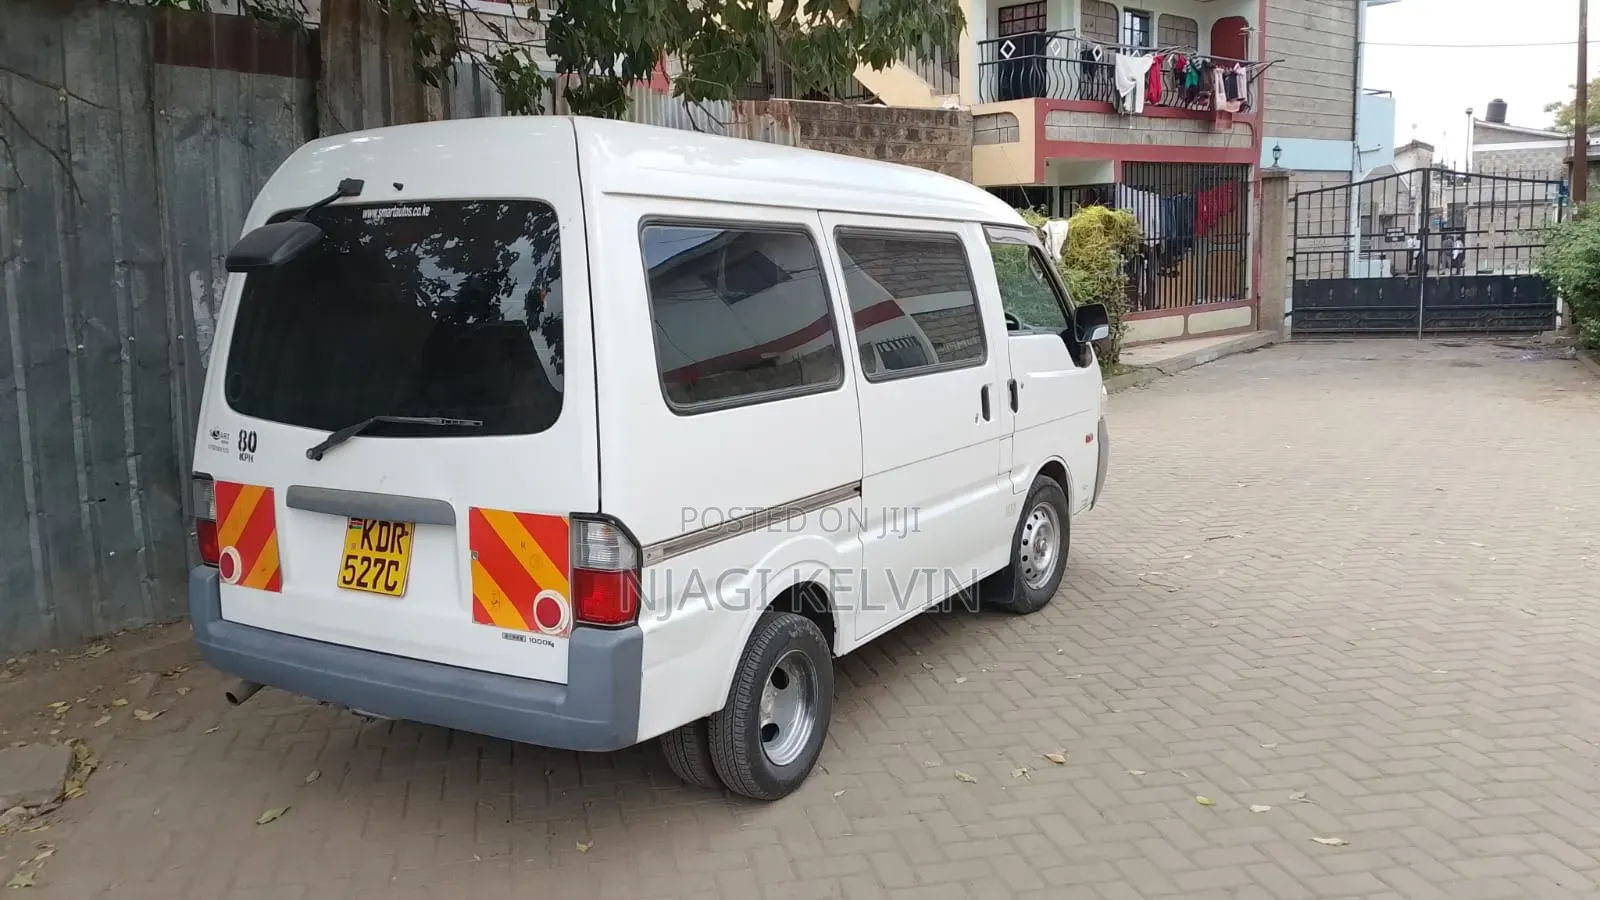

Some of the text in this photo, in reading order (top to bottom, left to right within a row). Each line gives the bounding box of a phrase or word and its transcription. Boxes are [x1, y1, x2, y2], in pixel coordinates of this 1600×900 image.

[238, 429, 258, 453] 80
[239, 452, 254, 463] KPH
[361, 518, 409, 555] KDR
[342, 554, 400, 592] 527C
